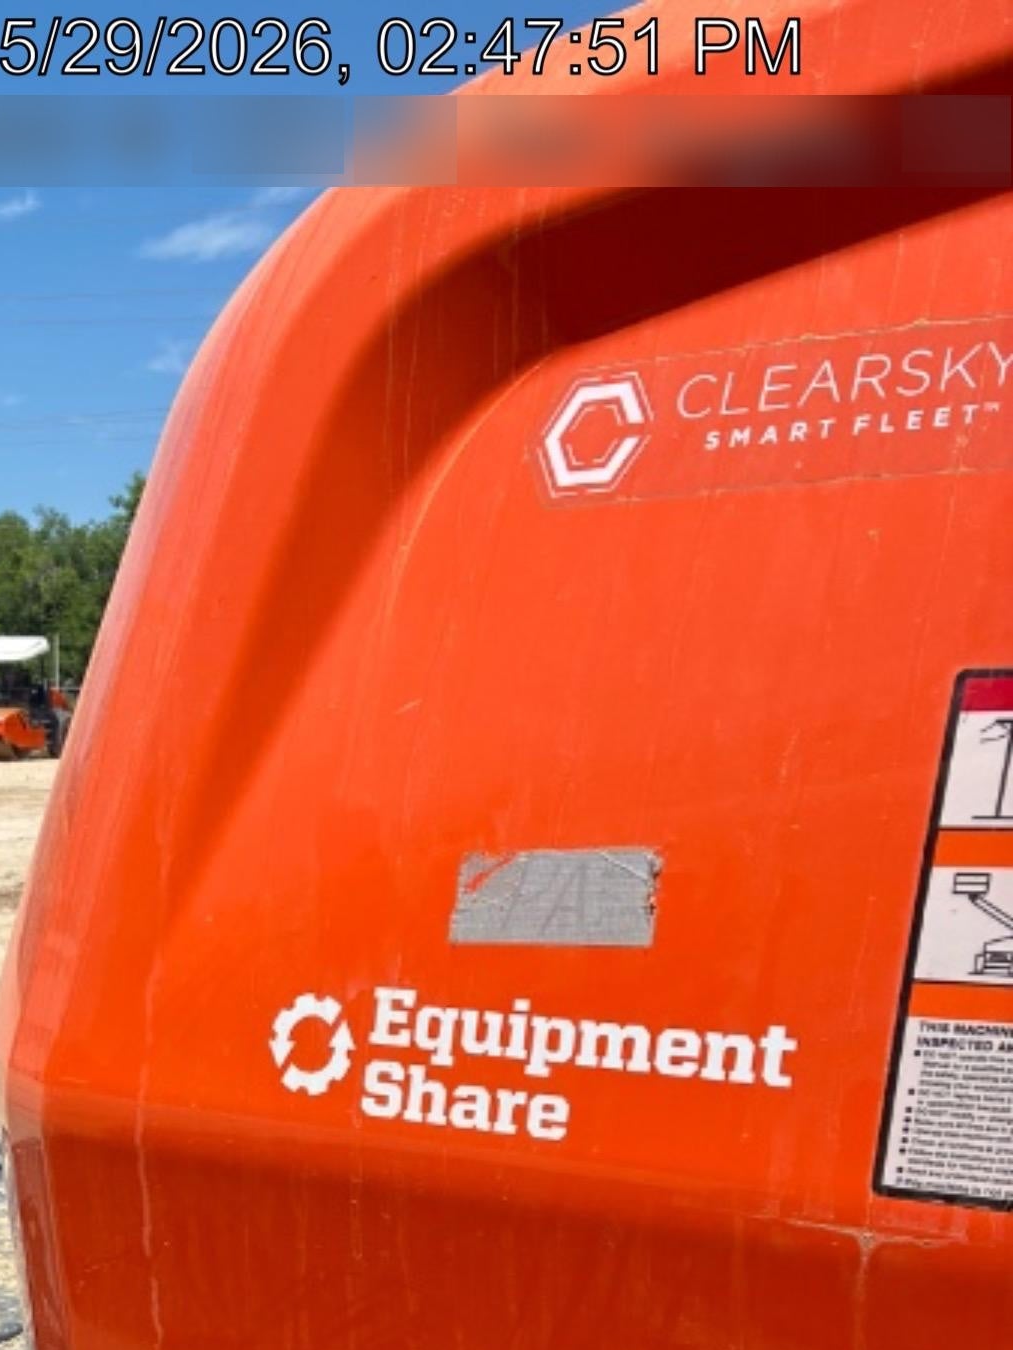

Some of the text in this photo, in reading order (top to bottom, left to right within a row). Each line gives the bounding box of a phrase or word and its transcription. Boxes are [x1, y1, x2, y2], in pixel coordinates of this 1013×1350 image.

[676, 341, 1013, 419] CLEARSKY
[704, 418, 837, 451] SMART
[368, 986, 798, 1088] Equipment
[360, 1059, 571, 1141] Share
